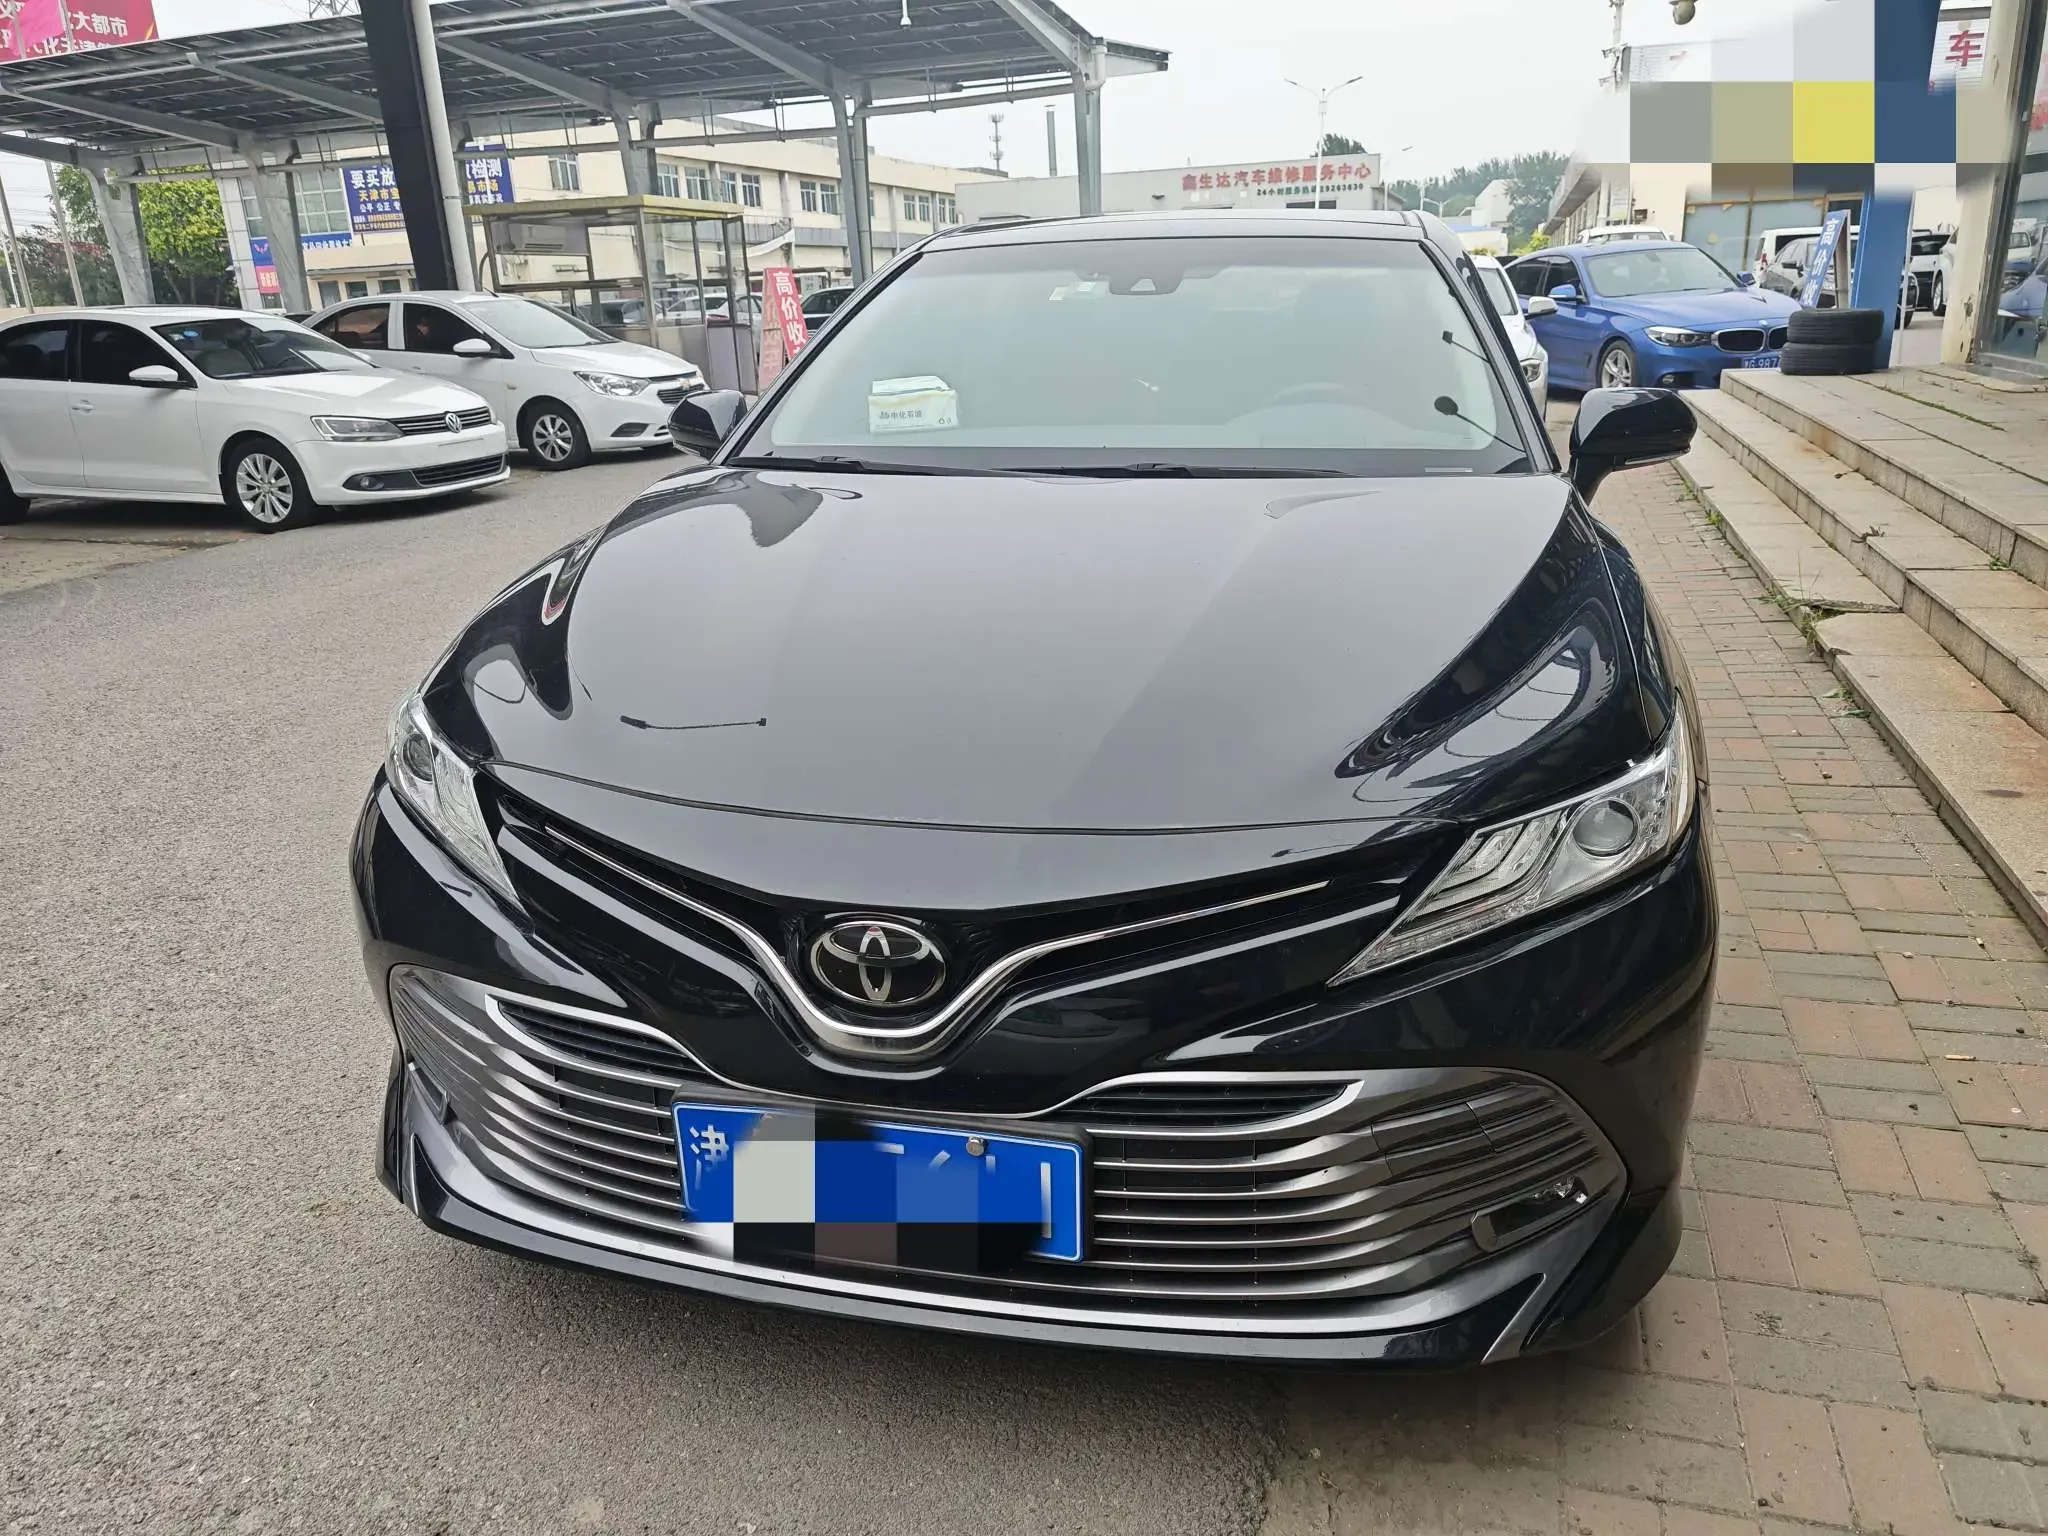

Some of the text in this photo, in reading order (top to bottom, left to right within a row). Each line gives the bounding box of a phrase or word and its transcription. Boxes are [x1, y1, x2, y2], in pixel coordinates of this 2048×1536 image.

[67, 11, 128, 37] 大都市
[1945, 29, 1985, 67] 车
[465, 158, 503, 180] 检测
[773, 271, 808, 354] 高价收
